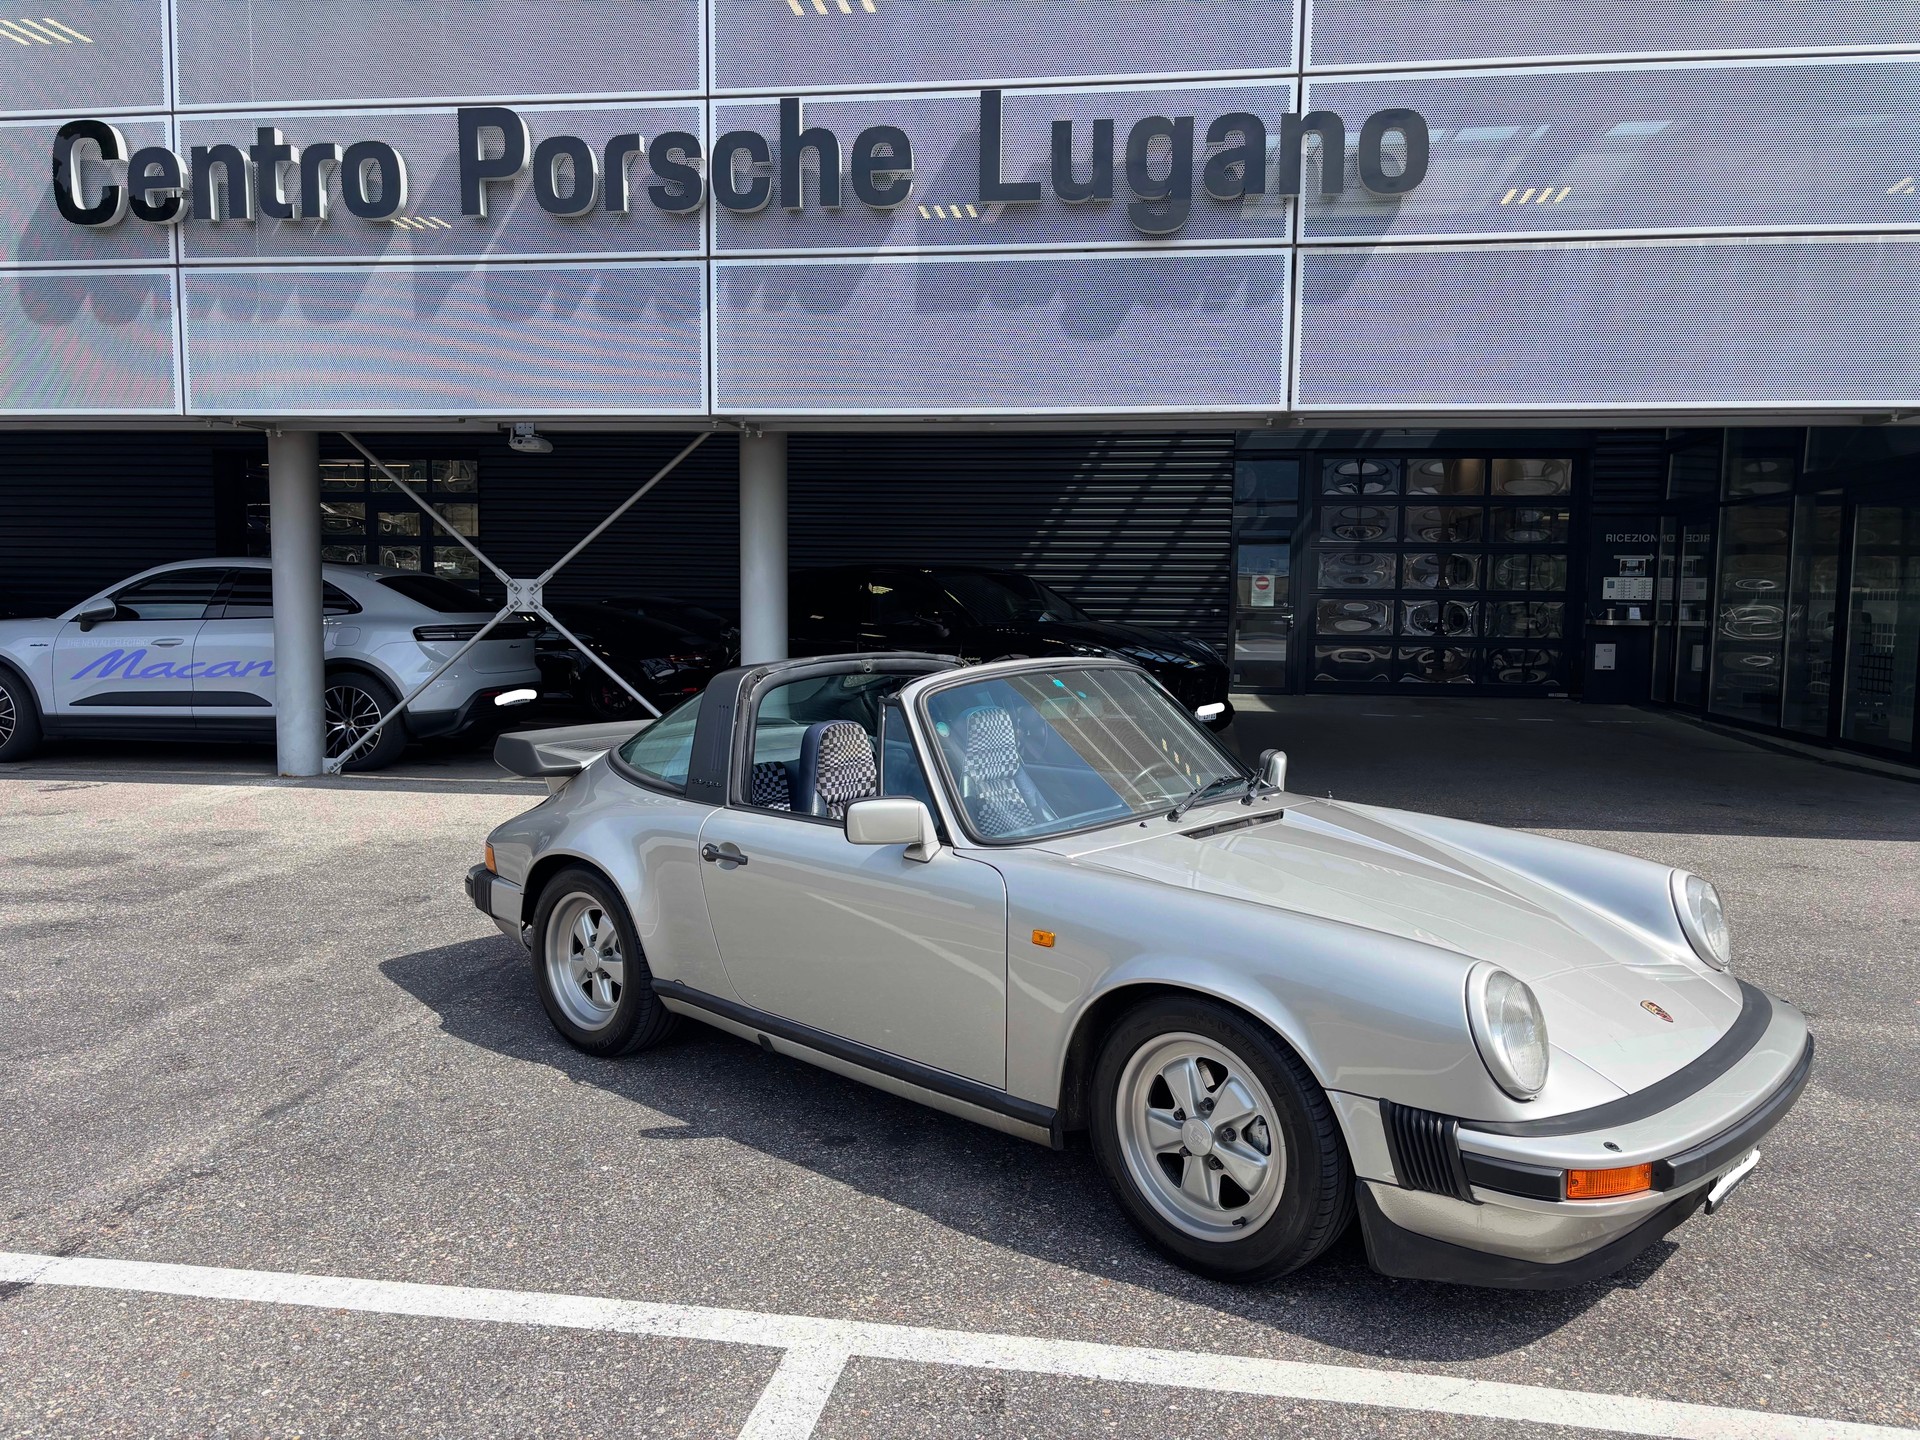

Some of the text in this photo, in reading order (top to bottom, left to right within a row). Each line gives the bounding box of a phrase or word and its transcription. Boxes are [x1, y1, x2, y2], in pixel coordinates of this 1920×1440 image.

[52, 90, 1431, 234] Centro Porsche Lugano
[70, 648, 276, 681] Macan
